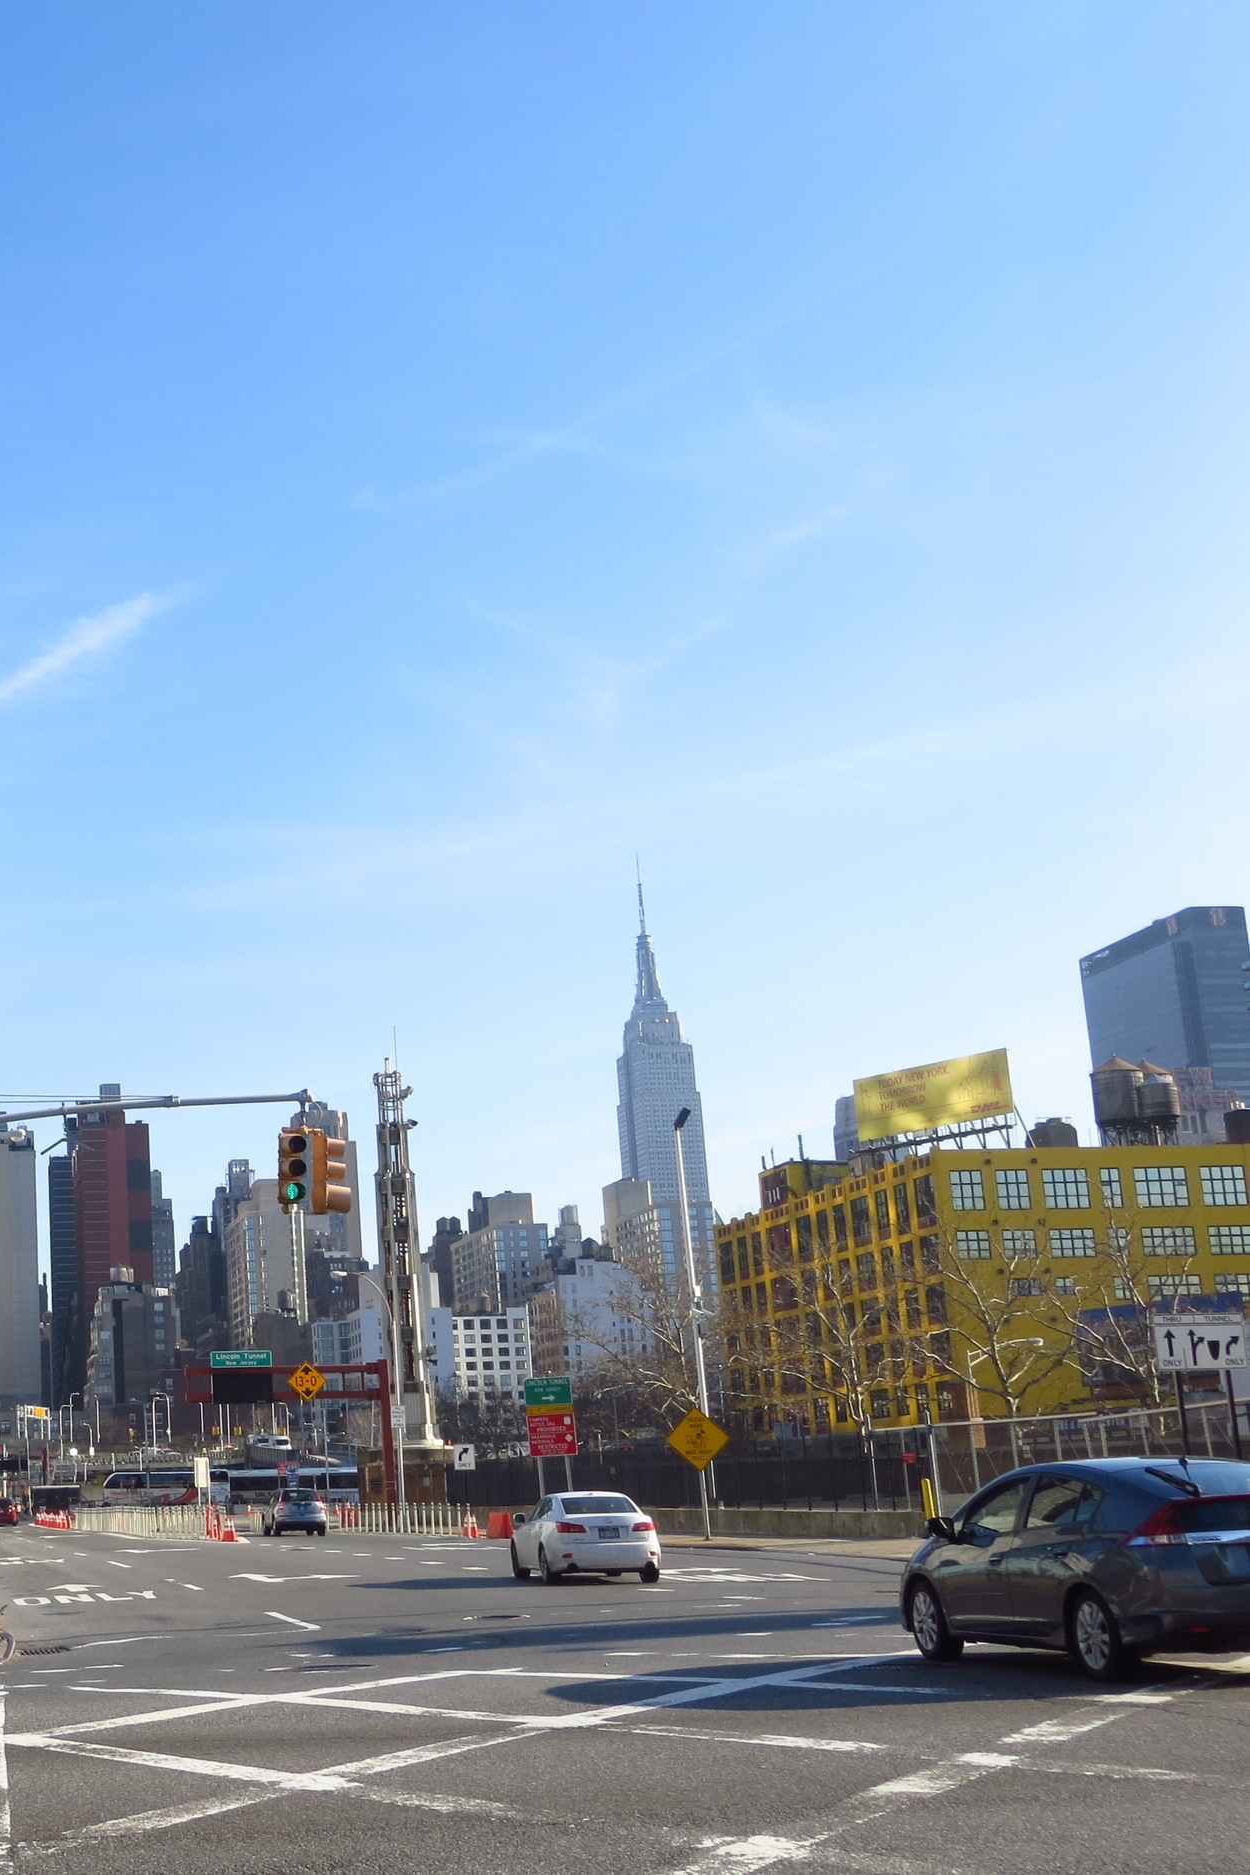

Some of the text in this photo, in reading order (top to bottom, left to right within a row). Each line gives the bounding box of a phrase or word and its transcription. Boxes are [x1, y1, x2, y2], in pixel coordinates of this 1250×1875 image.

[877, 1066, 951, 1089] TODAY NEW YORK.
[878, 1083, 927, 1100] TOMORROW
[880, 1095, 928, 1112] THE WORLD.
[970, 1101, 1002, 1114] DHL
[1162, 1359, 1182, 1367] ONLY
[1225, 1358, 1245, 1366] ONLY
[12, 1590, 158, 1606] ONLY
